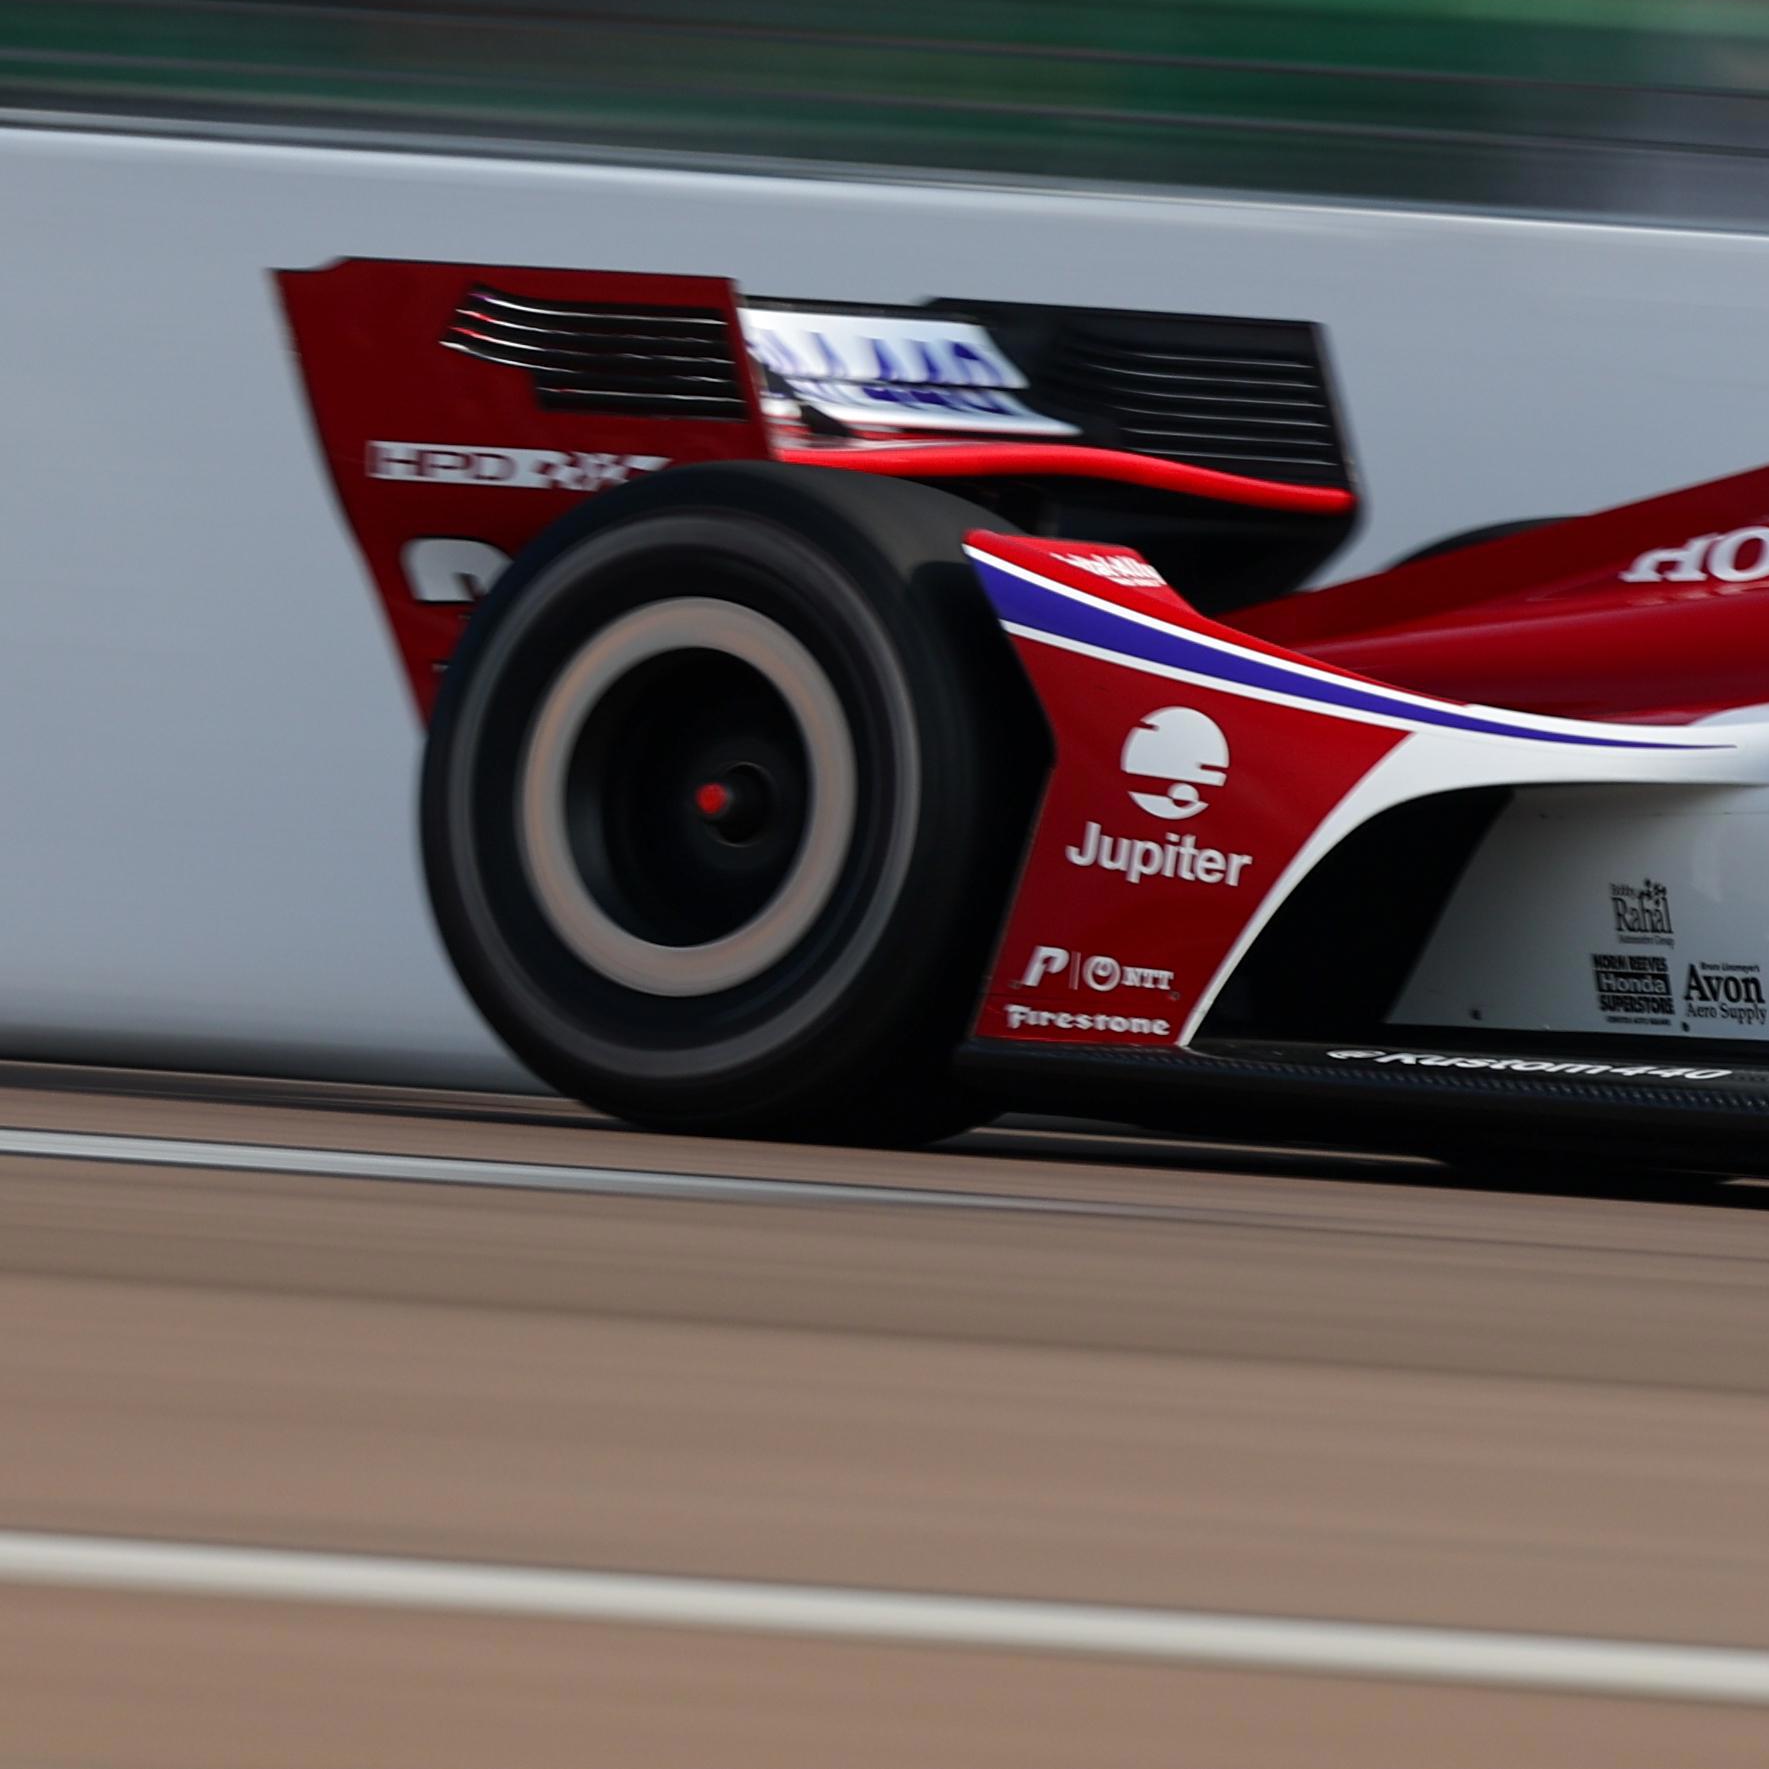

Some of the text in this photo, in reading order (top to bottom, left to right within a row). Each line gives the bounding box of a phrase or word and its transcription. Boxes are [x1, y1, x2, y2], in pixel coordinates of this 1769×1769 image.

[1066, 820, 1254, 887] Jupiter
[1610, 895, 1675, 935] Rahal
[1121, 966, 1175, 990] NTT
[1602, 973, 1668, 994] Honda
[1683, 963, 1767, 1004] Avon
[1004, 1003, 1171, 1036] Firestone
[1599, 995, 1676, 1016] SUPERSTORE
[1686, 1002, 1768, 1025] Aero Supply
